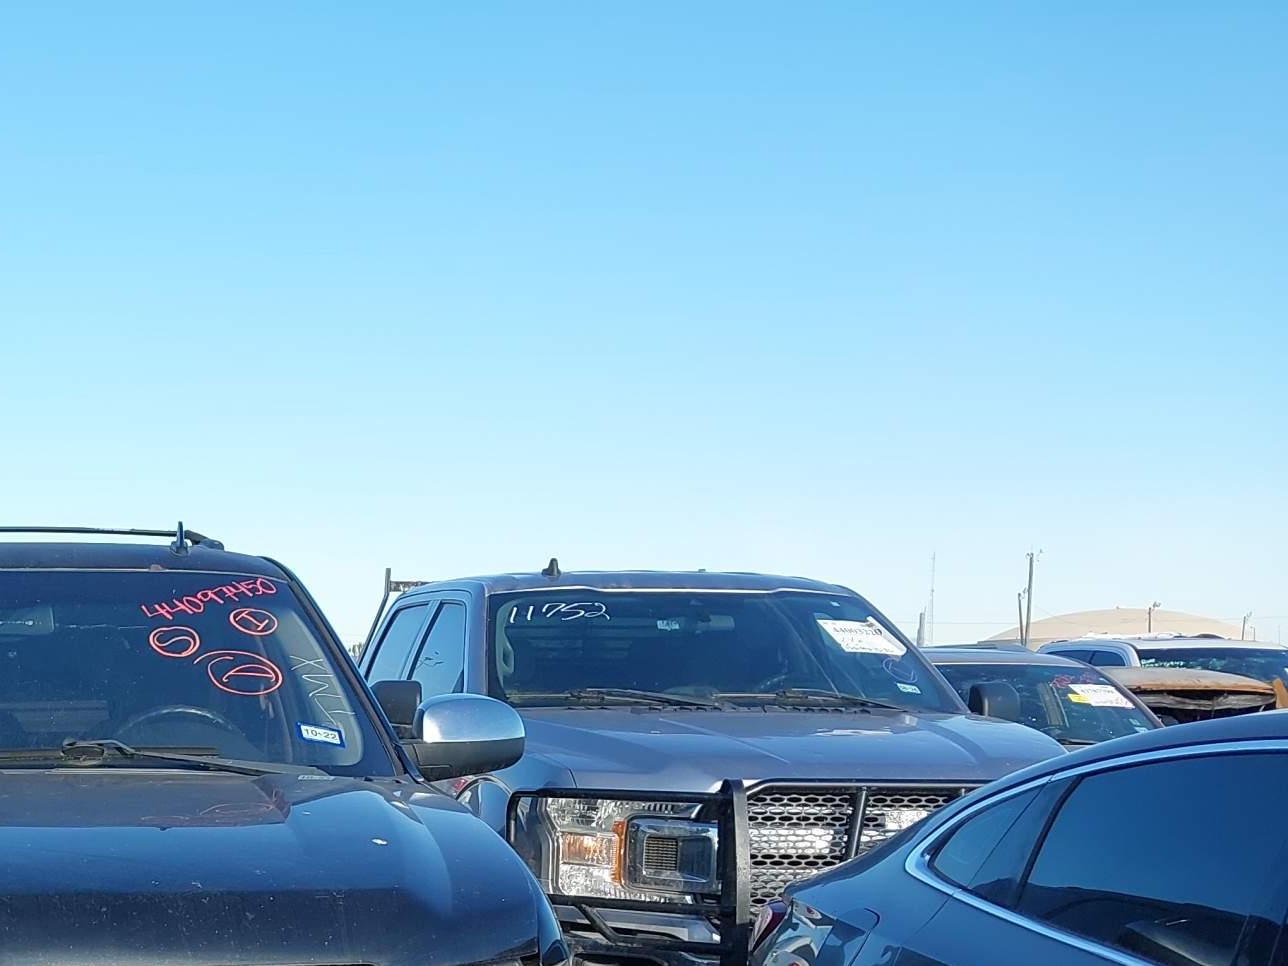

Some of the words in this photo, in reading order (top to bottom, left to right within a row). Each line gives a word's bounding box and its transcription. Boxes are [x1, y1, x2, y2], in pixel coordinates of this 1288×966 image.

[141, 577, 277, 620] 44097450
[509, 602, 610, 624] 11752
[303, 728, 338, 741] 10-22
